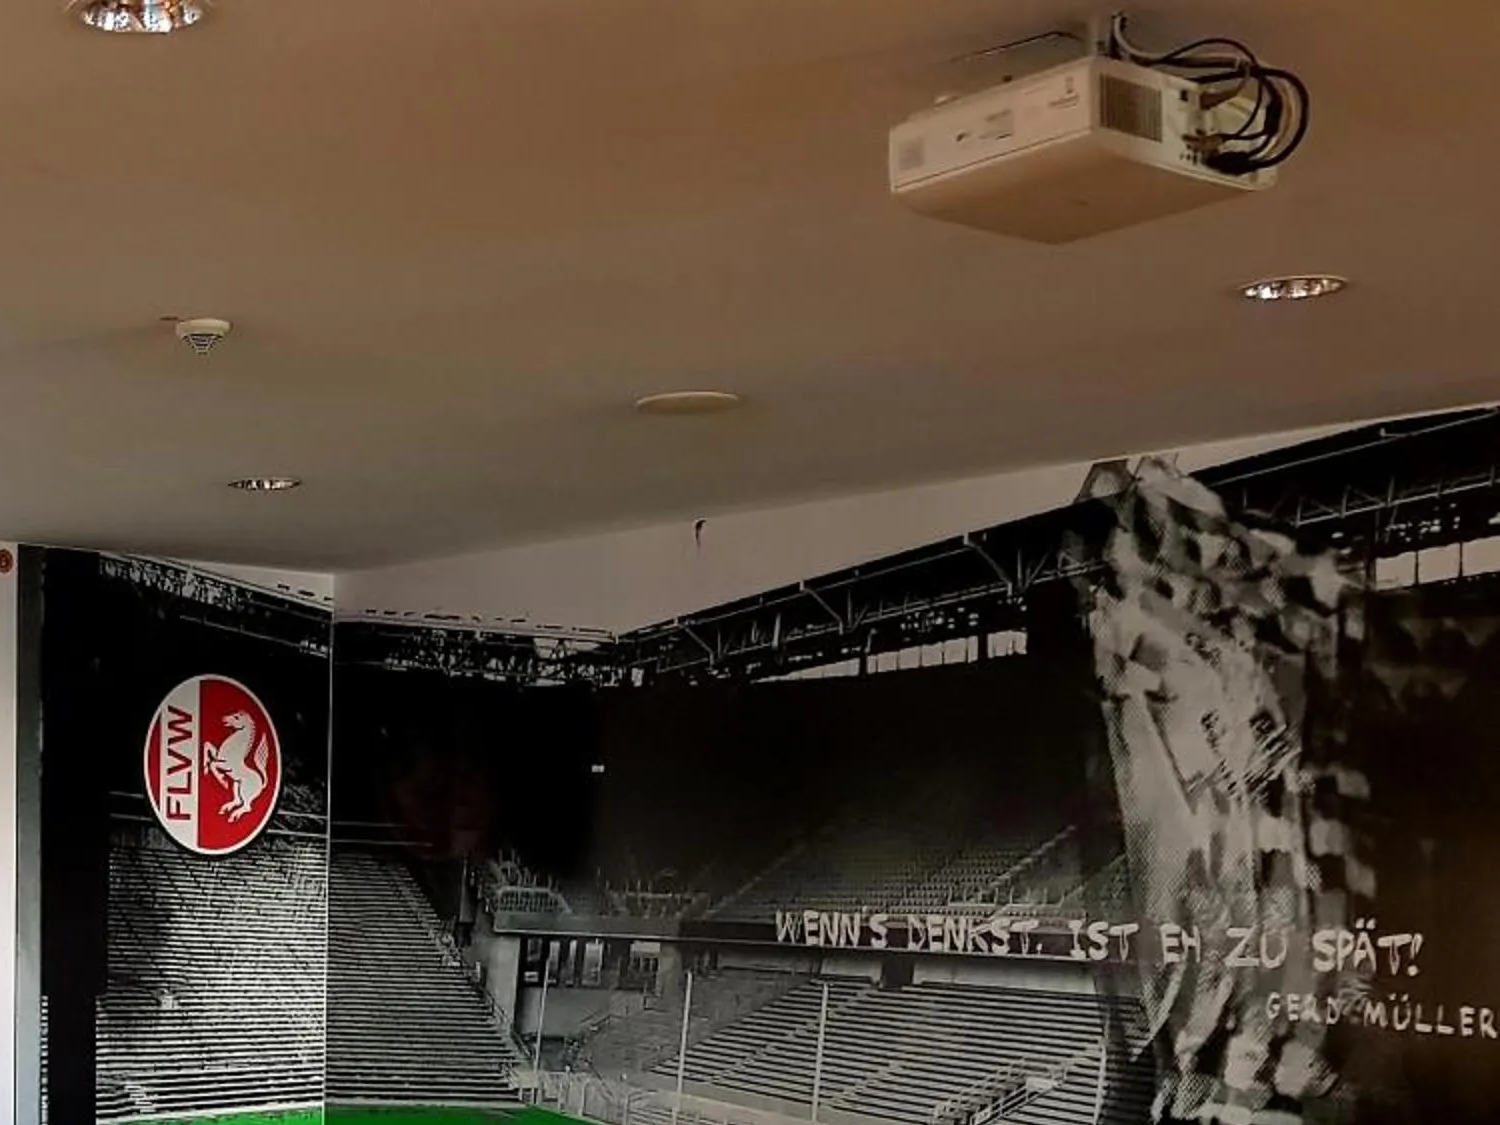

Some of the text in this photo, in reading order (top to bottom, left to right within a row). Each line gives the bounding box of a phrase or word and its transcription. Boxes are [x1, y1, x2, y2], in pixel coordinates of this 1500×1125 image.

[166, 705, 193, 821] FLVW
[1068, 919, 1139, 962] IST
[1160, 923, 1201, 965] EH
[1224, 927, 1288, 969] ZU
[1312, 917, 1424, 977] SPÄT!
[1264, 992, 1498, 1039] GERD MÜLLER
